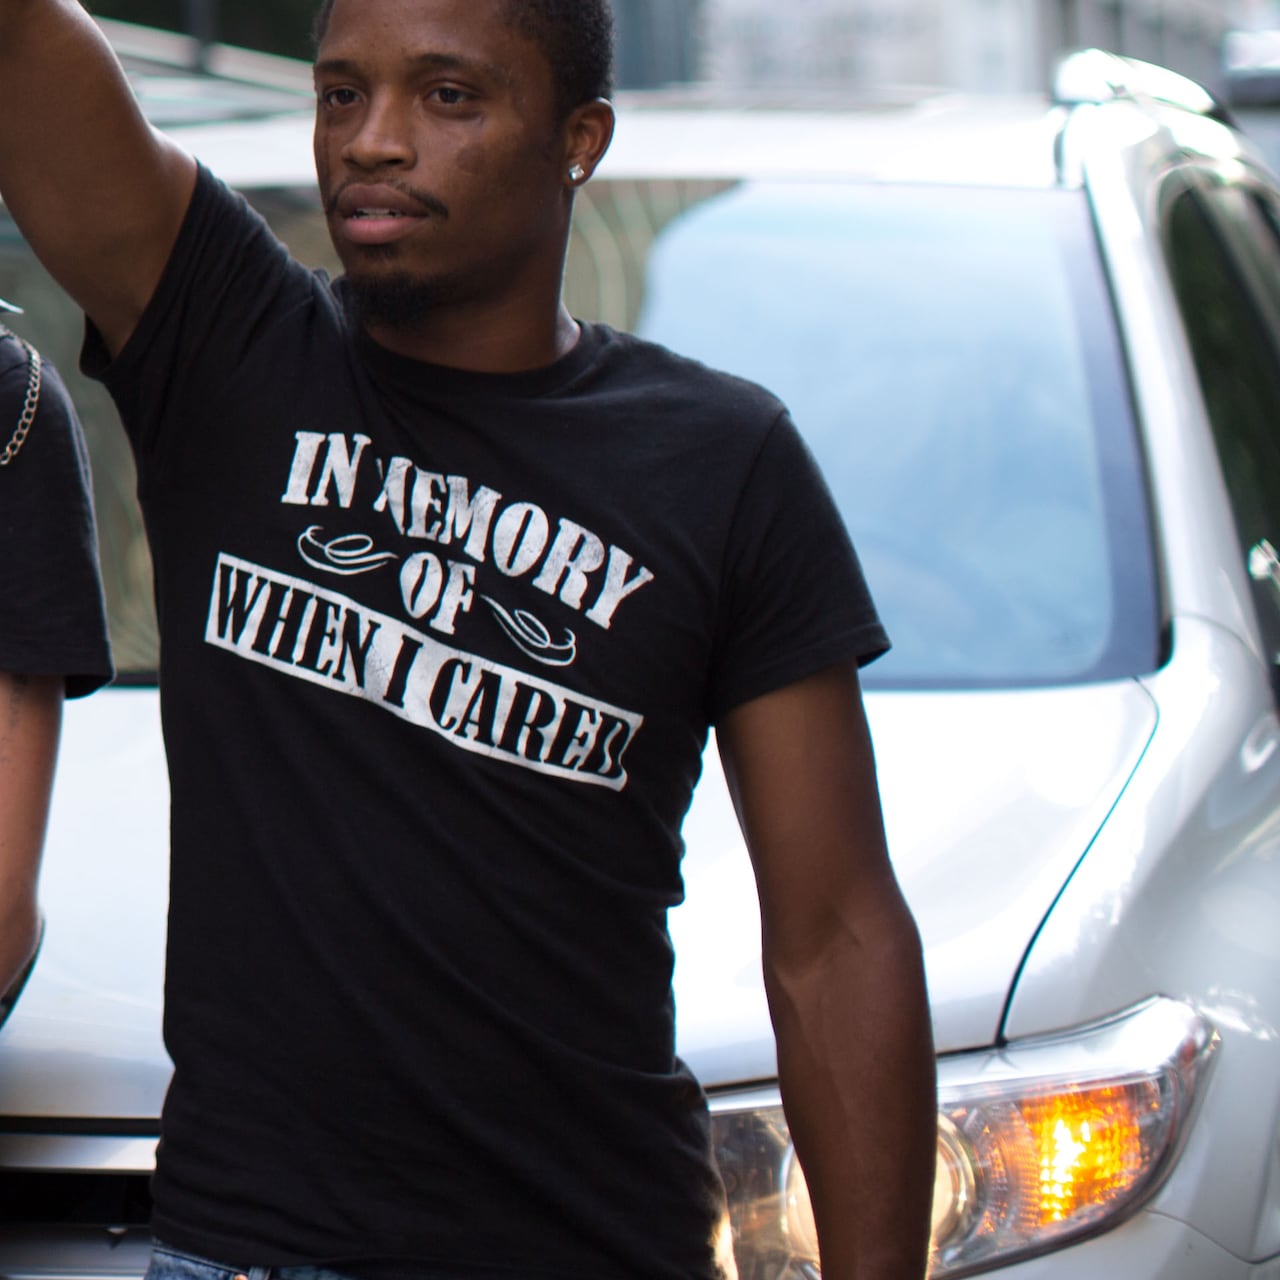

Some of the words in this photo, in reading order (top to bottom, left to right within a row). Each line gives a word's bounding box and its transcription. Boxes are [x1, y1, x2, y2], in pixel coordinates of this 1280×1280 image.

[280, 430, 372, 509] IN
[373, 455, 655, 630] MEMORY
[398, 551, 477, 636] OF
[215, 564, 382, 689] WHEN
[382, 633, 424, 709] I
[428, 656, 632, 781] CARED
